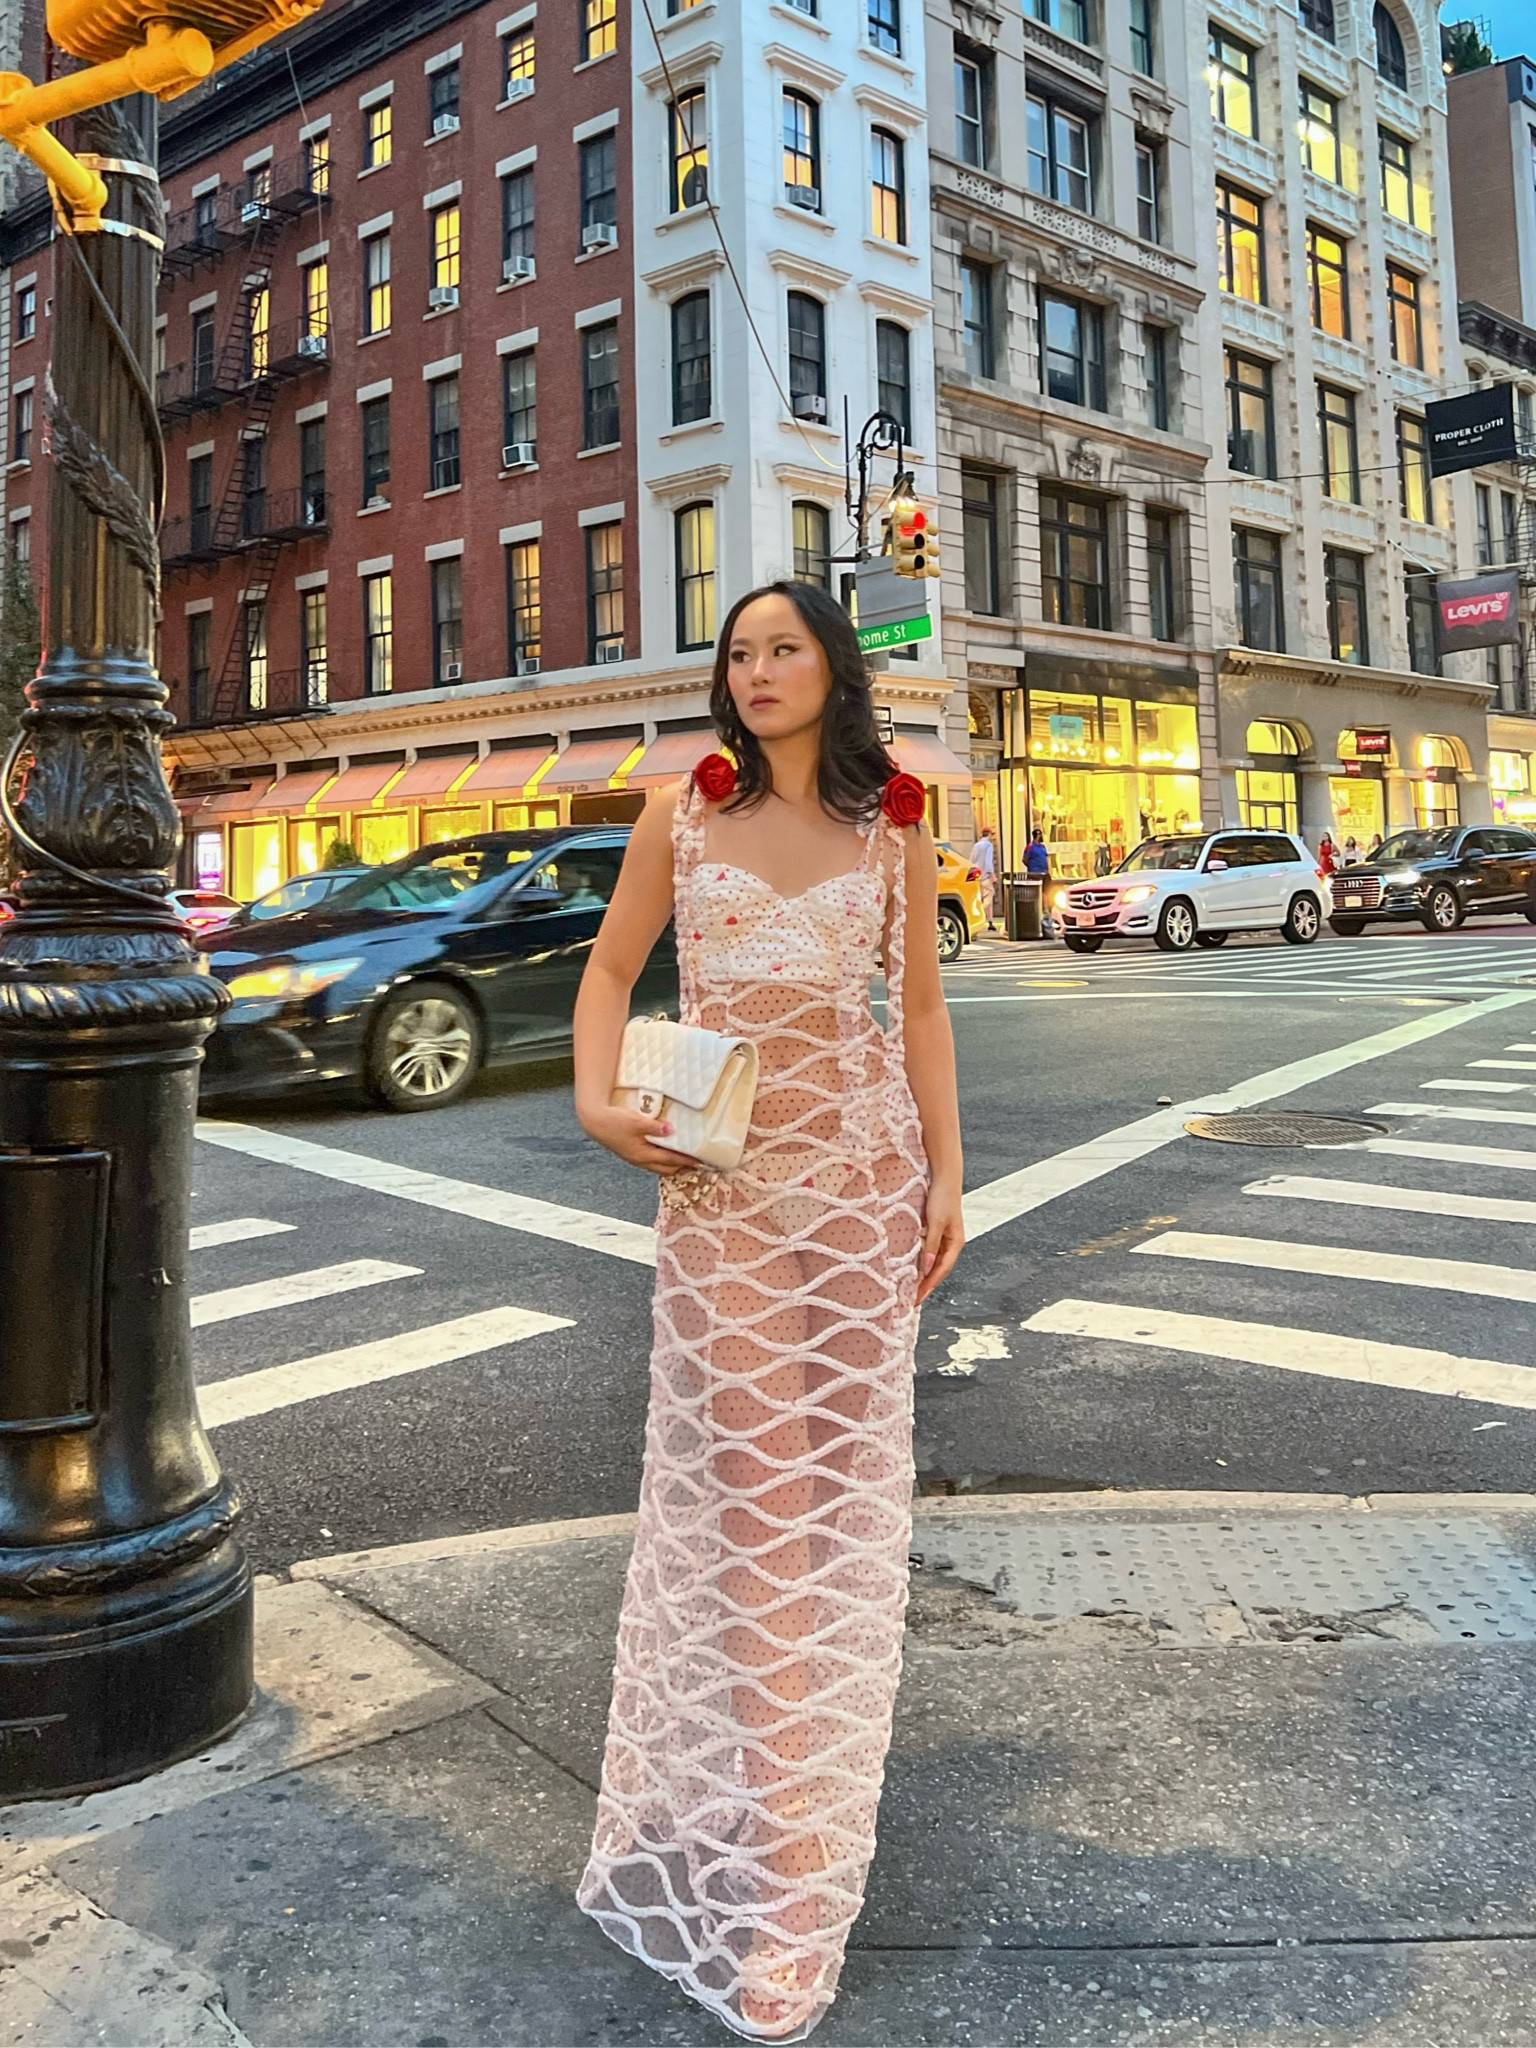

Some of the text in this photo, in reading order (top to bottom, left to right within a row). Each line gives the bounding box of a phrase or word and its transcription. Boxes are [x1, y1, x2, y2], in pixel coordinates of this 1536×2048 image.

[1435, 427, 1472, 442] PROPER
[1473, 417, 1504, 433] CLOTH
[894, 624, 906, 639] St
